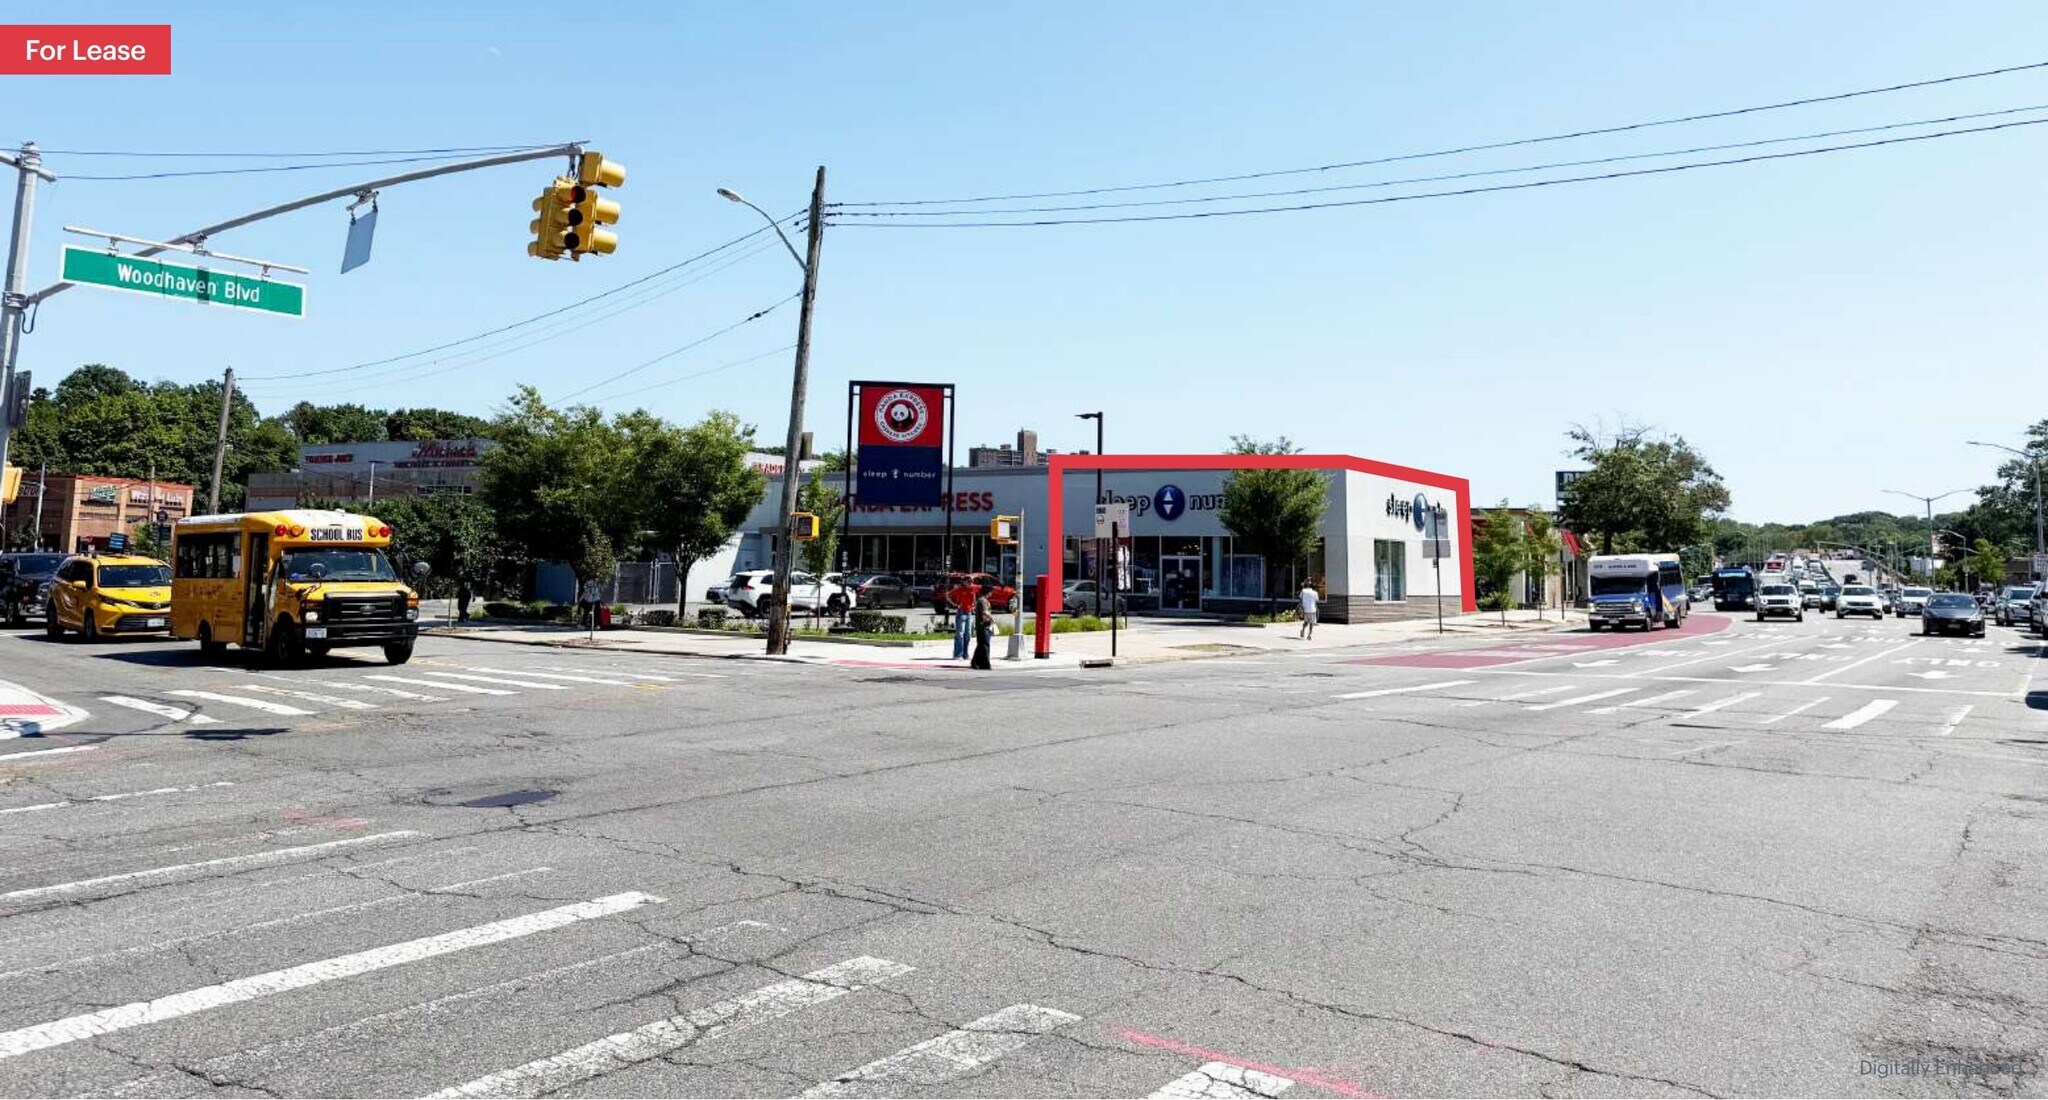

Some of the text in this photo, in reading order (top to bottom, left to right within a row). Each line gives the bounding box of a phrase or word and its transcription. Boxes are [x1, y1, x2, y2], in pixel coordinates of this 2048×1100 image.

[117, 263, 260, 303] Woodhaven Blvd
[863, 469, 936, 479] sleep number
[1386, 492, 1413, 524] sleep
[310, 528, 363, 541] SCHOOL BUS
[1890, 657, 2002, 668] ONLY
